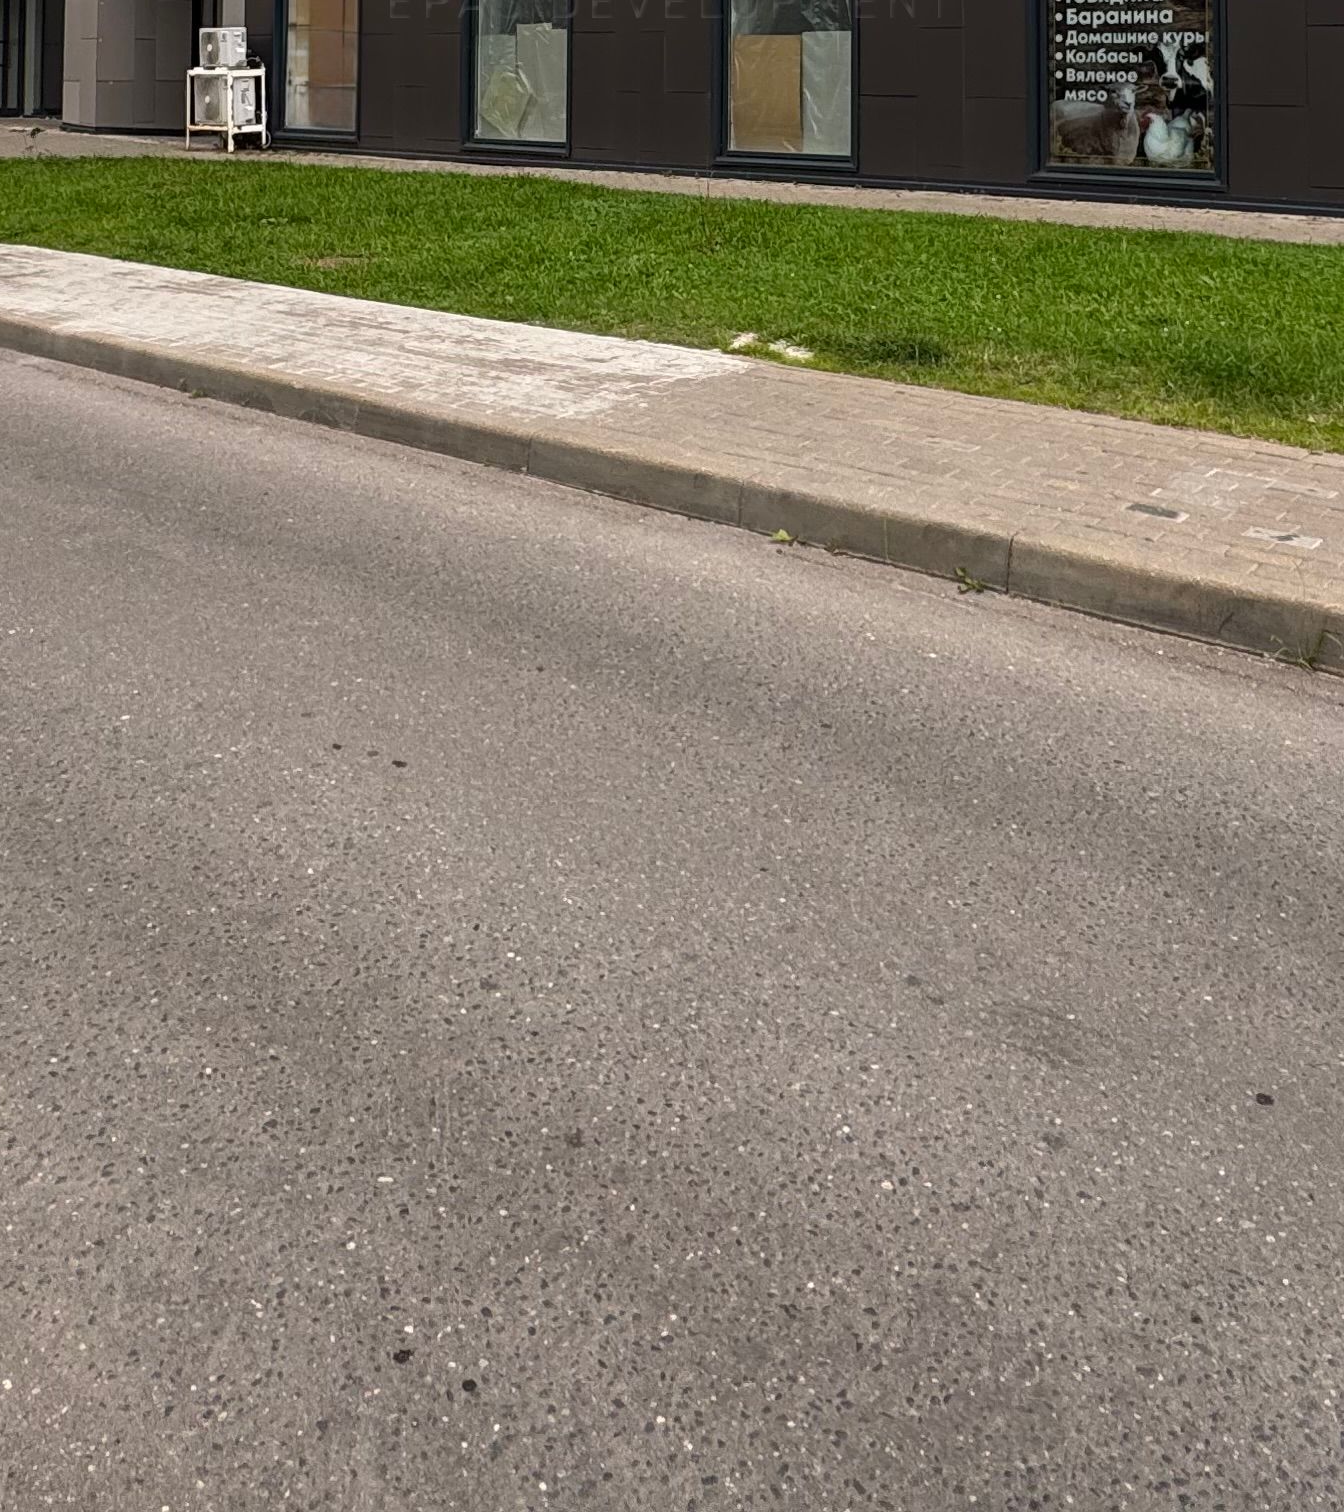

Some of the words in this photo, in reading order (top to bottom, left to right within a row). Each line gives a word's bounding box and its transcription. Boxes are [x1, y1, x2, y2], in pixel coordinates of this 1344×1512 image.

[1065, 8, 1174, 26] Баранина
[1065, 31, 1159, 47] Домашние
[1162, 30, 1210, 45] куры
[1065, 48, 1143, 64] Колбасы
[1065, 69, 1138, 83] Вяленое
[1064, 90, 1108, 103] мясо
